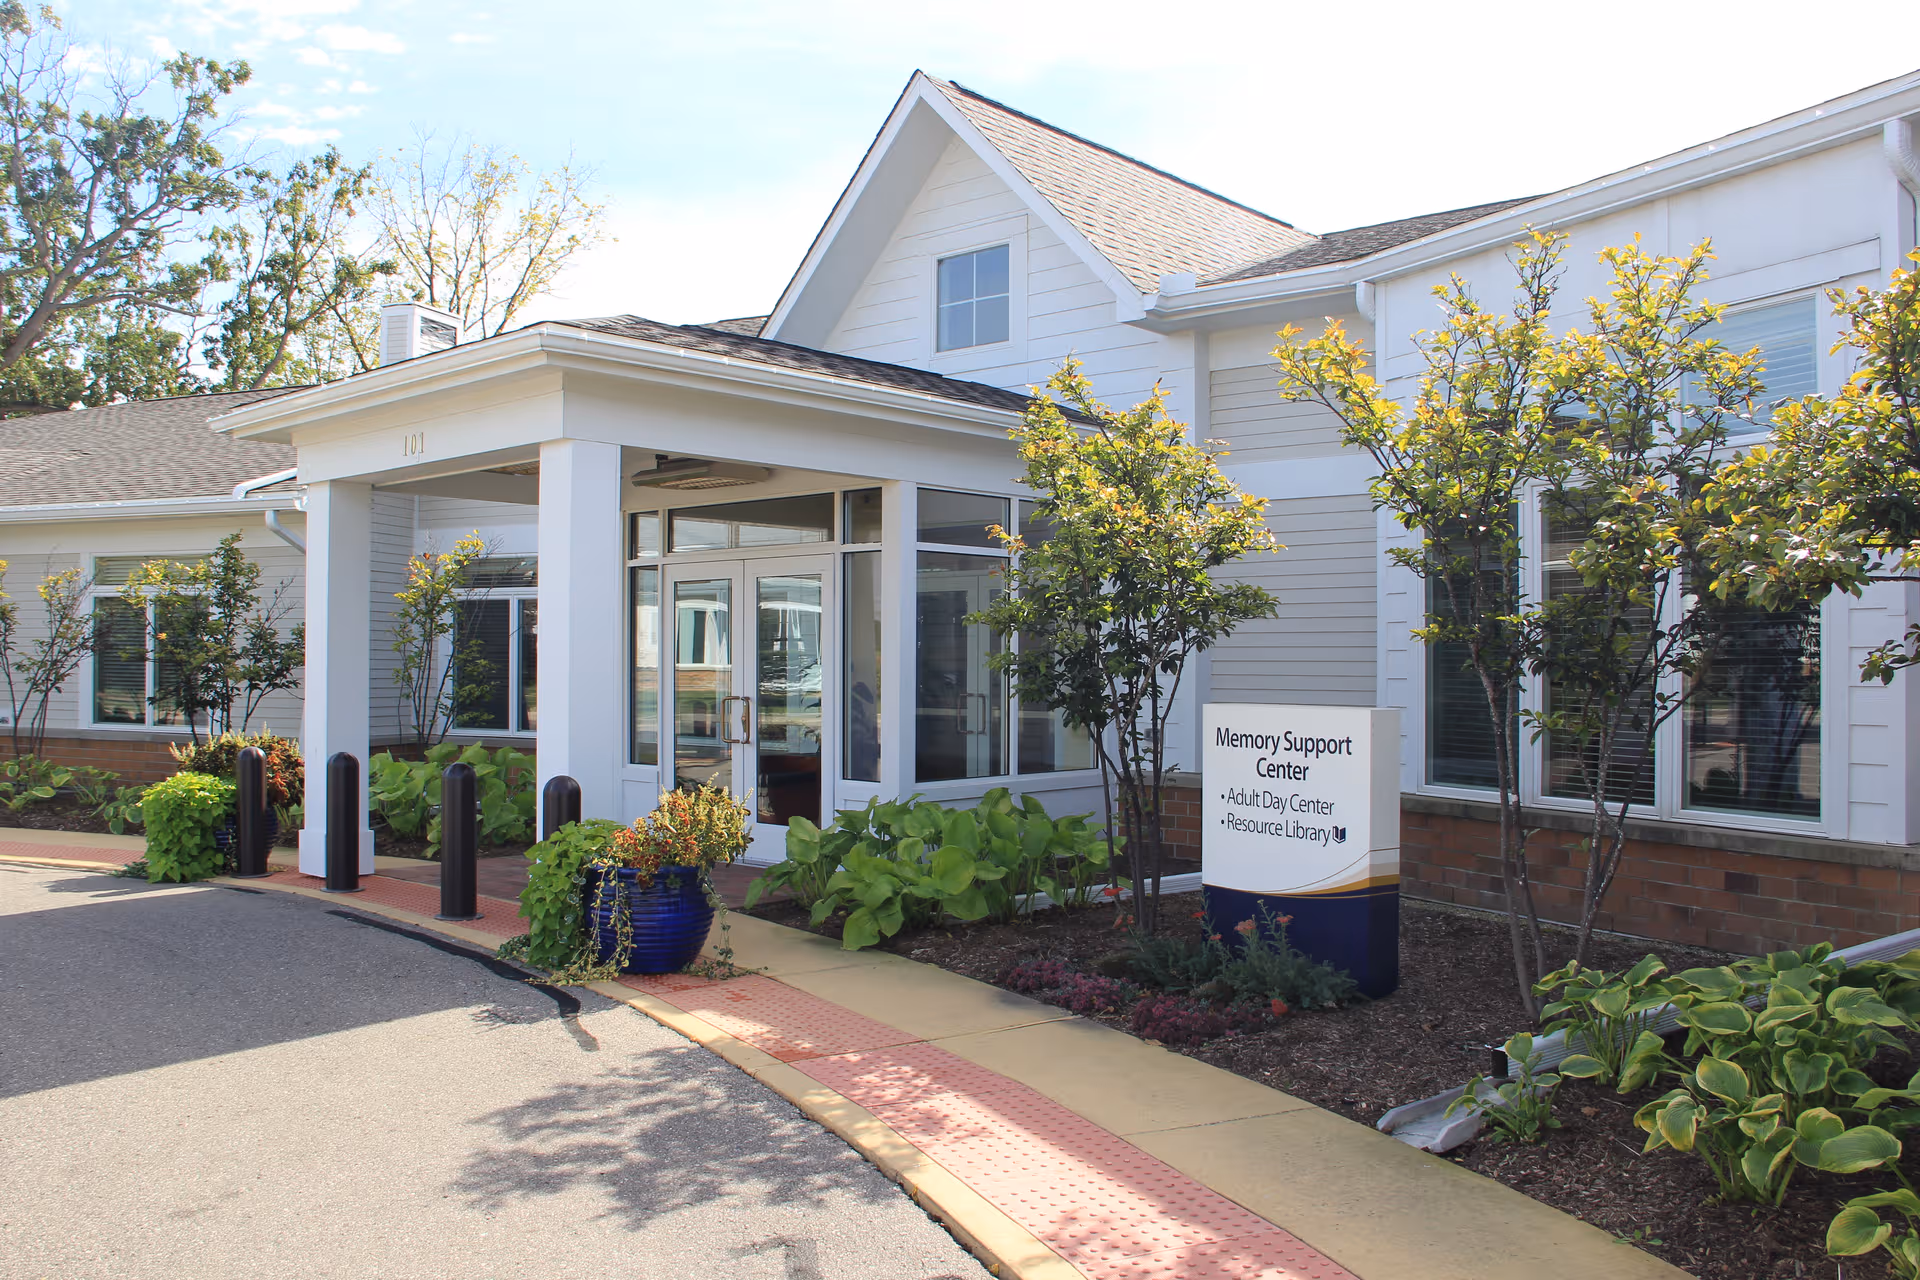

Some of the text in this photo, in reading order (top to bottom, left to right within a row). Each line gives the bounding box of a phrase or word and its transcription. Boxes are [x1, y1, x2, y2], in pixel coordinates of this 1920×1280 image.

[403, 432, 424, 456] 101
[1216, 727, 1352, 758] Memory Support
[1256, 757, 1309, 781] Center
[1227, 788, 1335, 815] Adult Day Center
[1227, 812, 1331, 847] Resource Library
